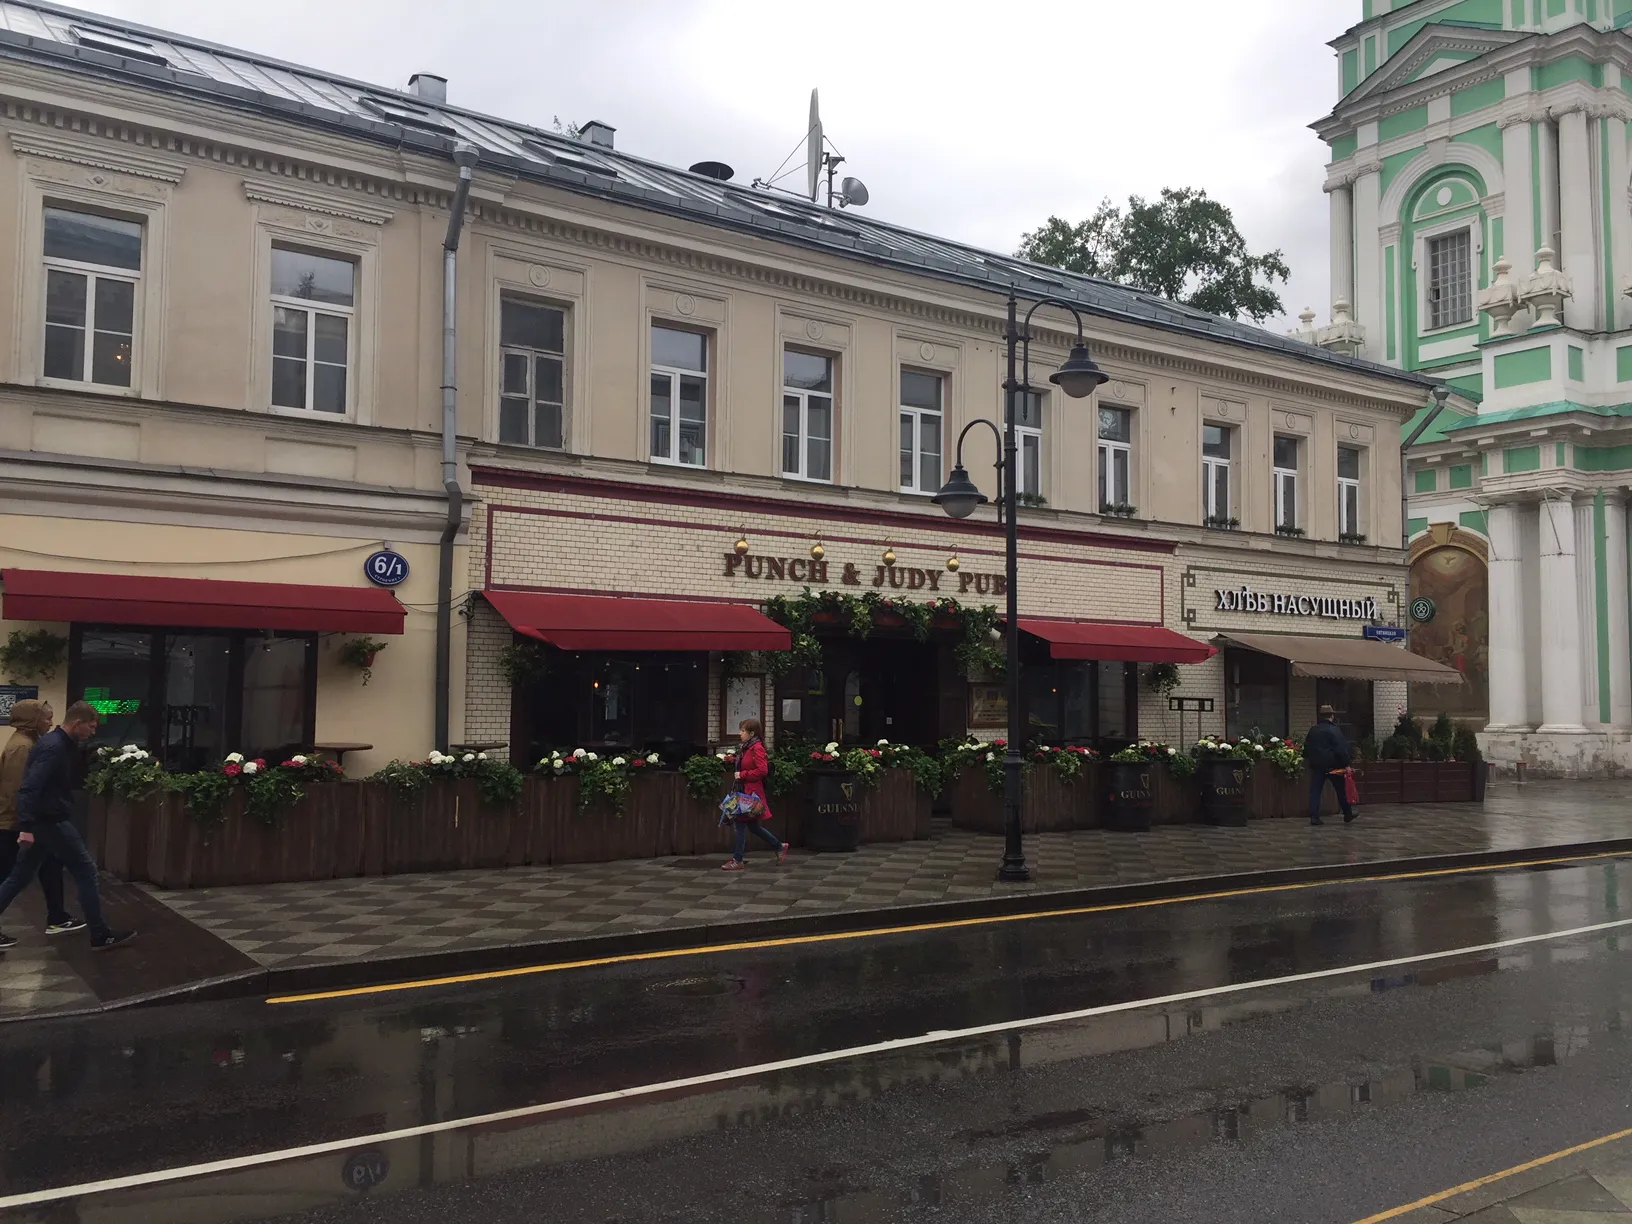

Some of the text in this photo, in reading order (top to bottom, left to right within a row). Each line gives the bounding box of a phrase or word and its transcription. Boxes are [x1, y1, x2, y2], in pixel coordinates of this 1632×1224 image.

[375, 556, 402, 576] 6/1
[723, 553, 1007, 595] PUNCH & JUDY PUB
[1273, 593, 1378, 620] НАСУЩНЫЙ
